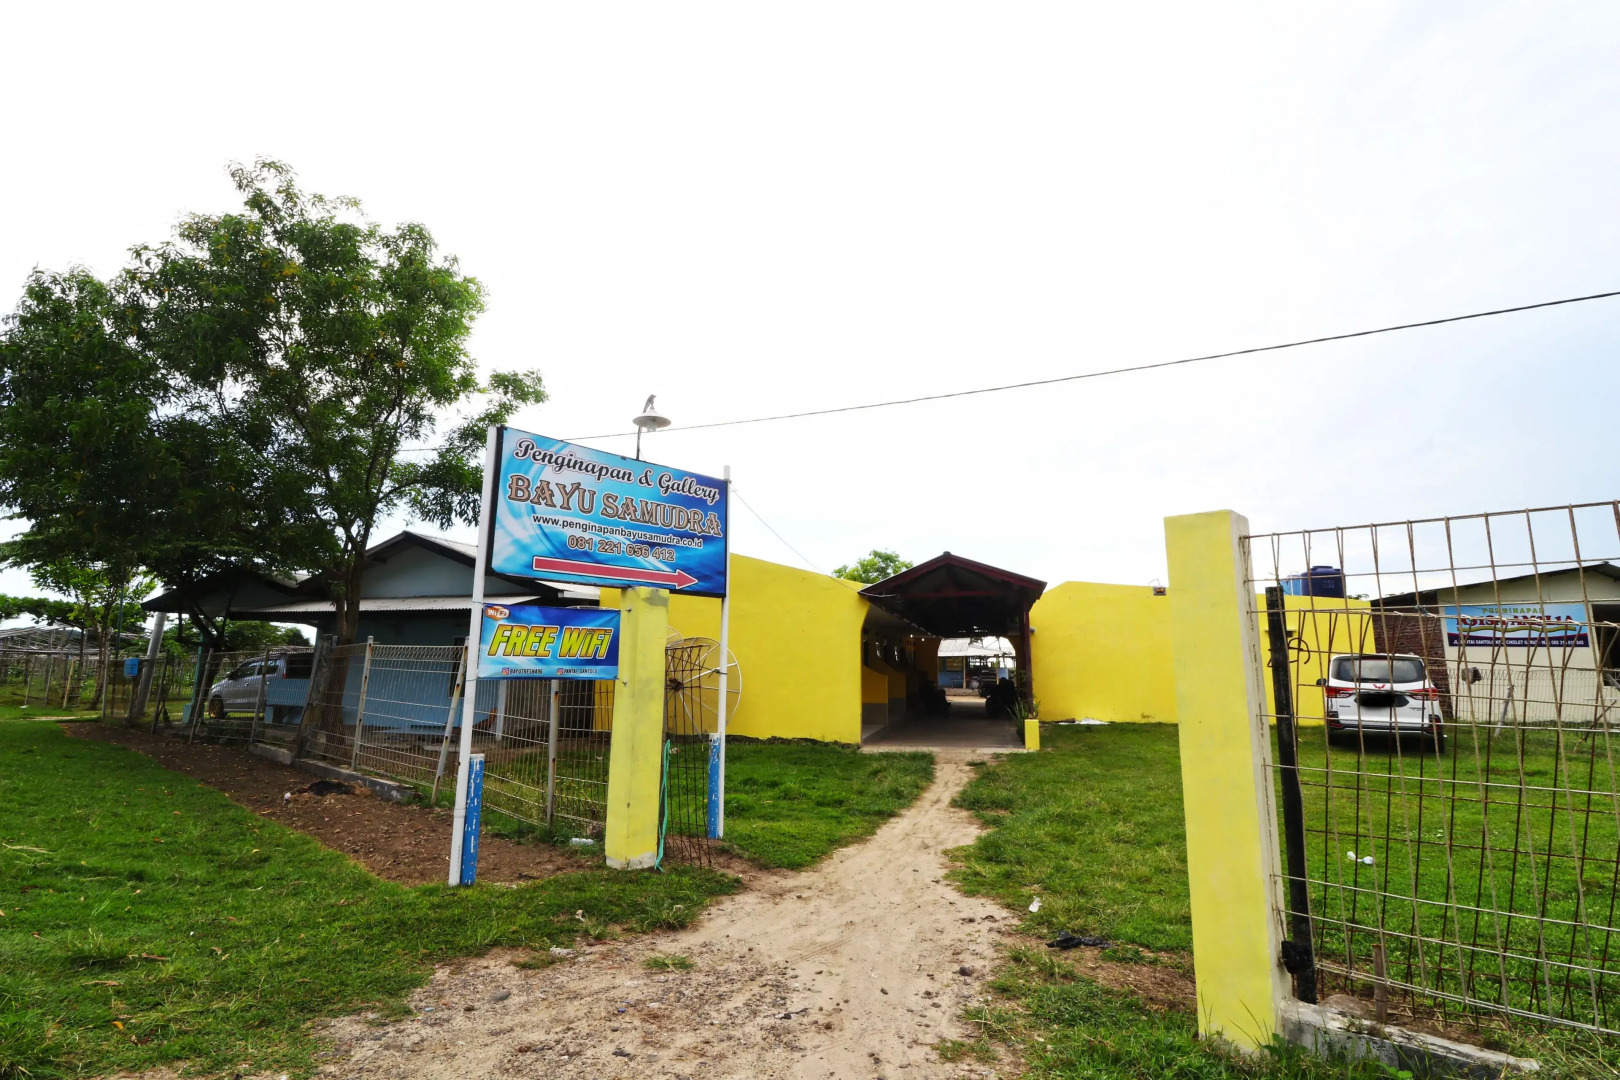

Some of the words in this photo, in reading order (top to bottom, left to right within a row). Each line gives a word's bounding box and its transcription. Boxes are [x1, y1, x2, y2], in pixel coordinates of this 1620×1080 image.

[514, 438, 633, 482] Penginapan
[638, 469, 654, 487] &
[658, 472, 719, 504] Gallery
[508, 474, 596, 515] BAYU
[601, 493, 723, 537] SAMUDRA
[532, 514, 703, 548] www.penginapanbayusamudra.co.id
[568, 535, 593, 550] 081
[598, 540, 621, 555] 221
[626, 544, 650, 558] 656
[652, 548, 675, 562] 412
[488, 624, 558, 657] FREE
[559, 626, 613, 658] WiFi
